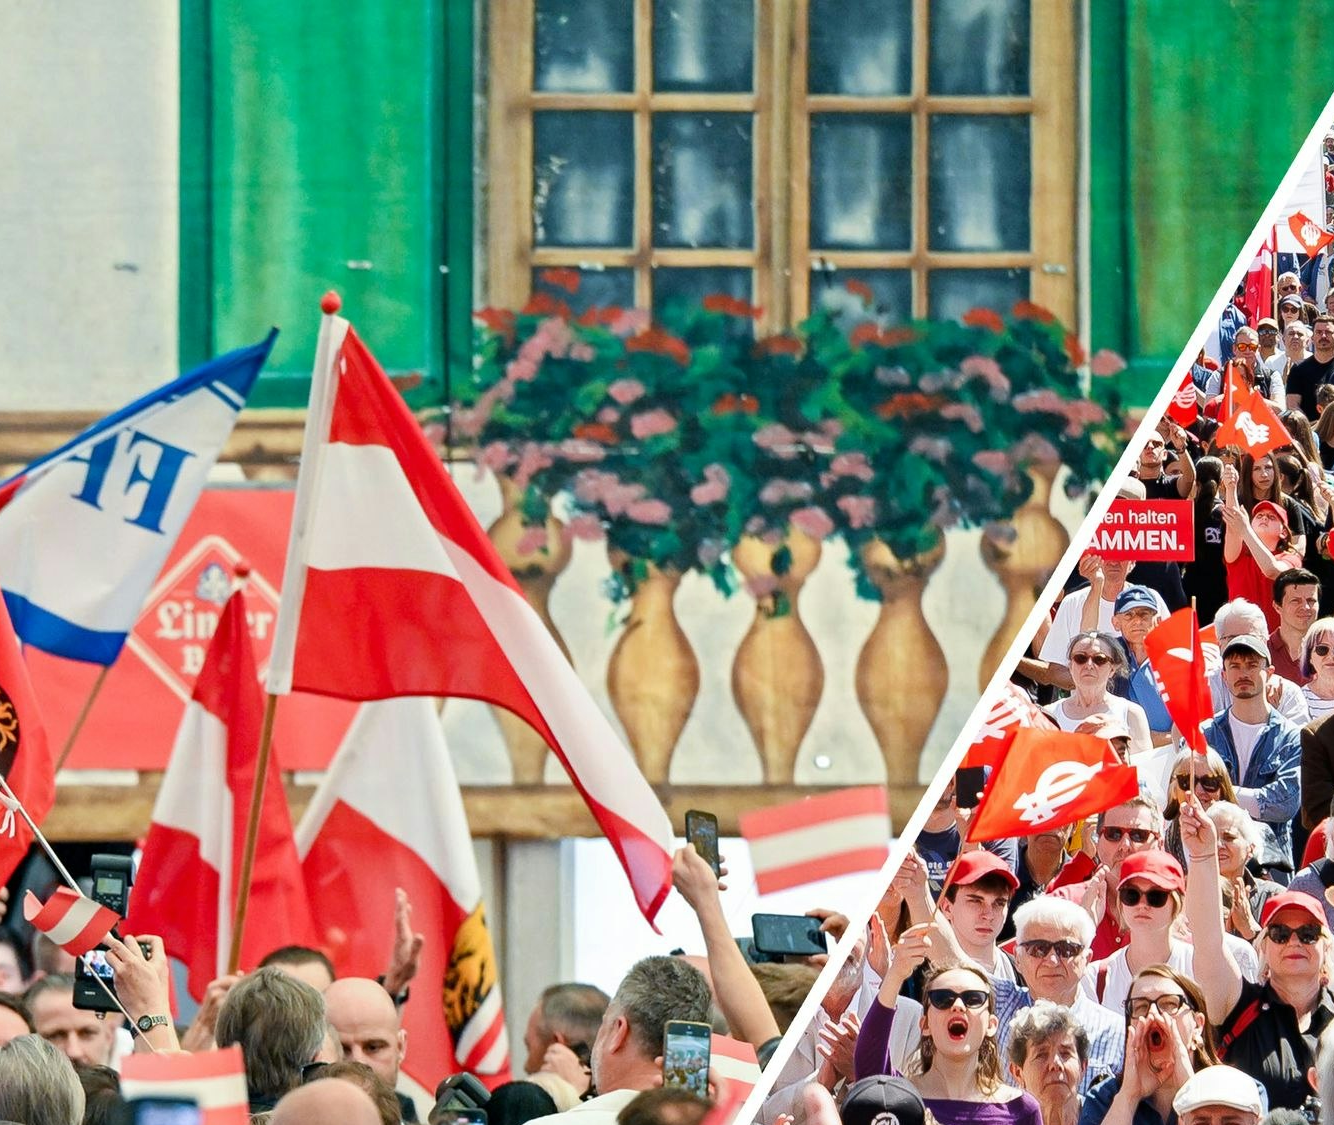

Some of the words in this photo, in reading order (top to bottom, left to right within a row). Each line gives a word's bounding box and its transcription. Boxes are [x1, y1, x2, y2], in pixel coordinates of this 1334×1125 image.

[1128, 509, 1177, 525] halten
[1087, 529, 1186, 551] AMMEN.
[155, 600, 273, 640] Linr
